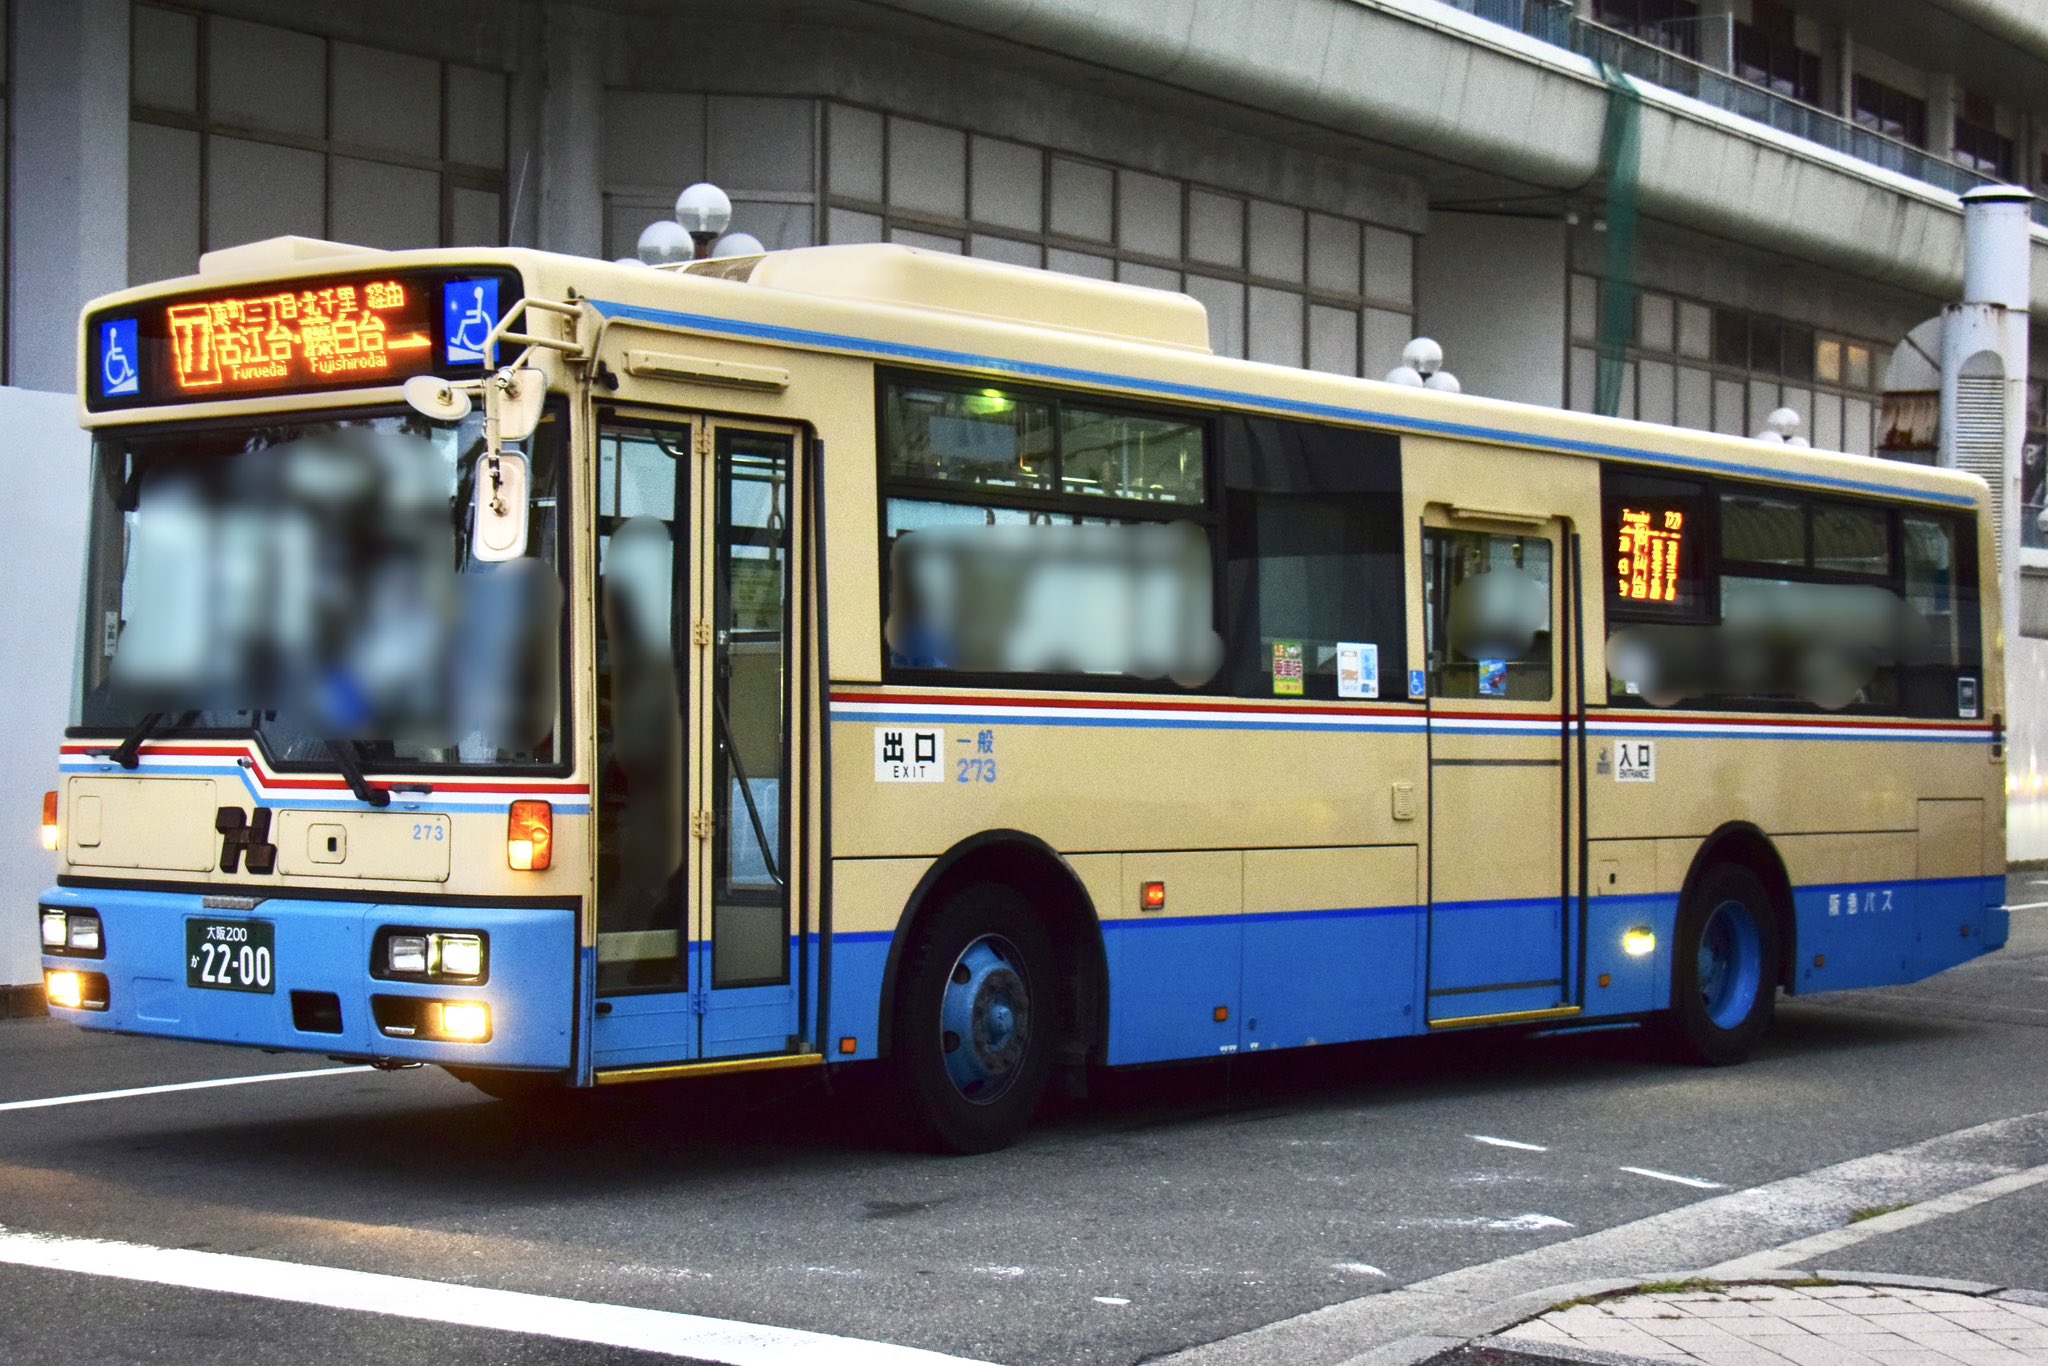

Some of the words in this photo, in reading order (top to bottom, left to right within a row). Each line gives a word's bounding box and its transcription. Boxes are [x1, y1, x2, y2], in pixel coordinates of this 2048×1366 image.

[363, 281, 405, 309] 経由
[309, 350, 387, 374] Fujishirodai
[883, 732, 936, 763] 出口
[956, 729, 995, 754] 一般
[1619, 744, 1650, 768] 入口
[893, 765, 926, 778] EXIT
[957, 758, 997, 783] 273
[412, 824, 444, 841] 273
[190, 955, 200, 968] か
[201, 943, 271, 987] 22-00
